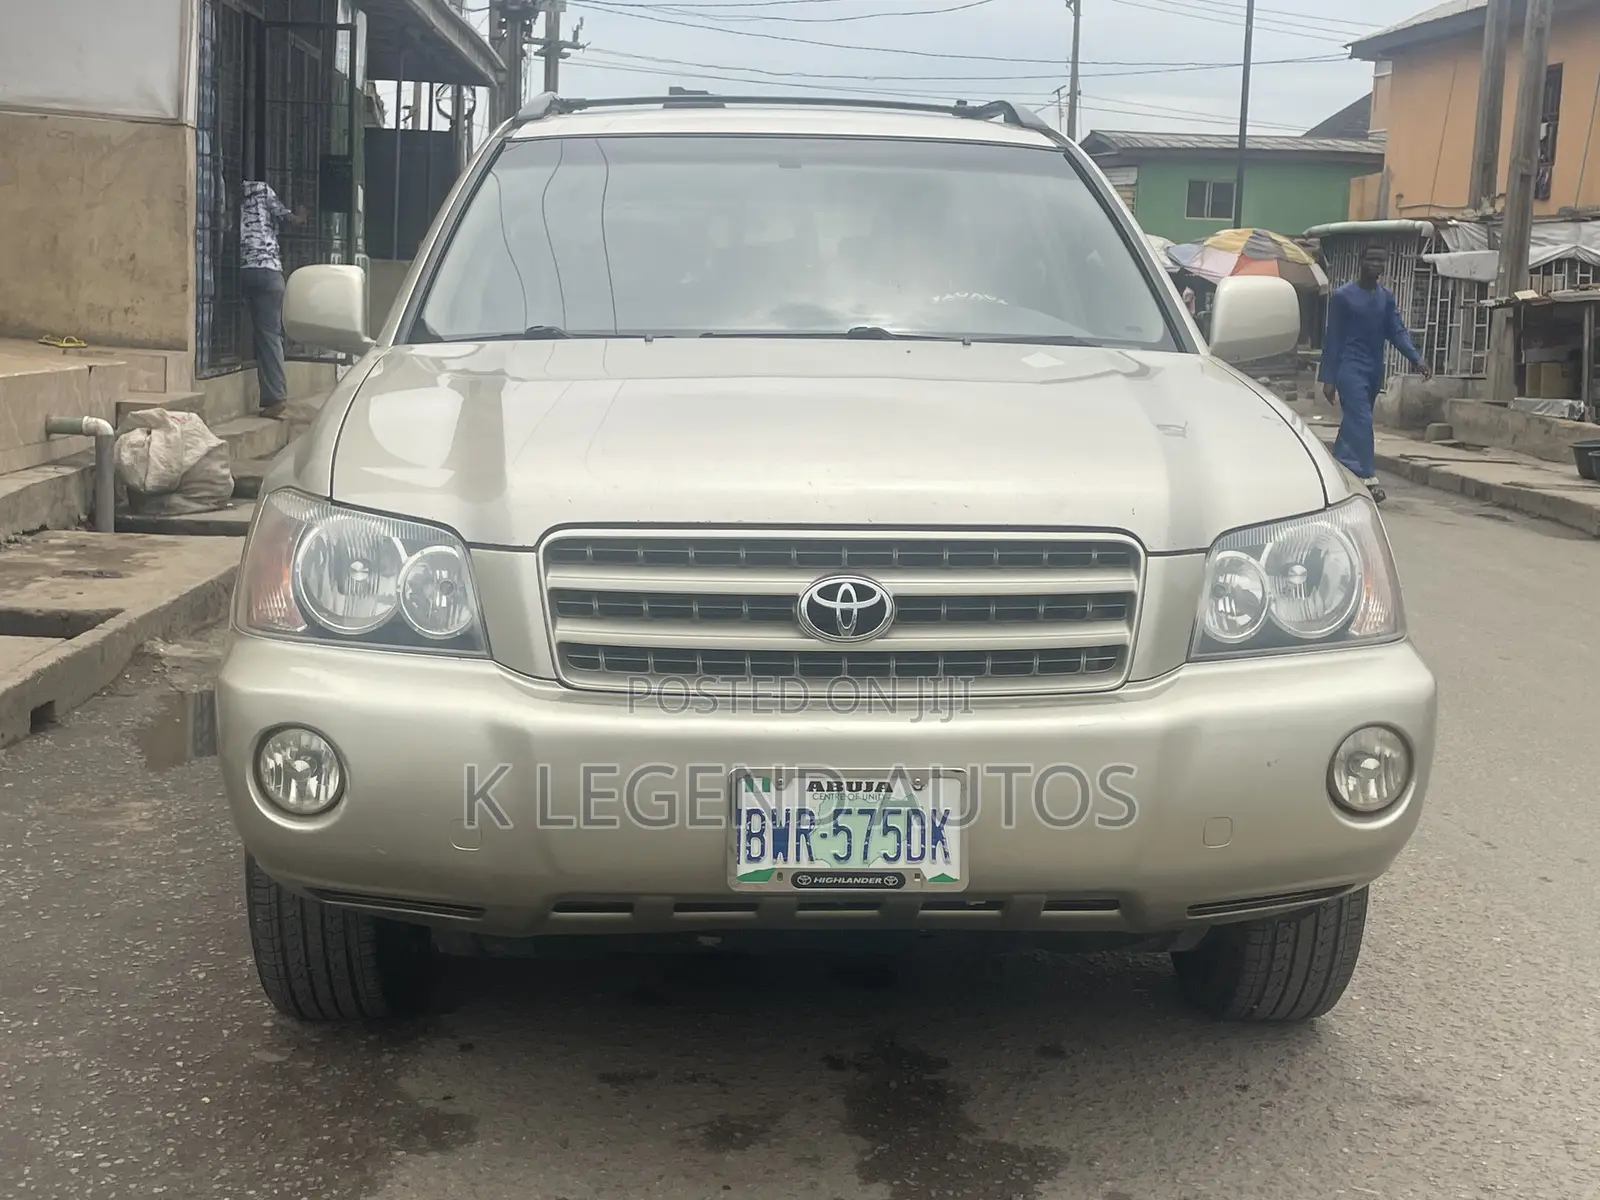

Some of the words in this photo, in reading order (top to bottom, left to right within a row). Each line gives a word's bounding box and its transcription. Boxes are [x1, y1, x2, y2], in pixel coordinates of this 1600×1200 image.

[806, 781, 893, 792] ABUJA
[812, 793, 845, 801] CENTRE
[848, 793, 862, 801] OF
